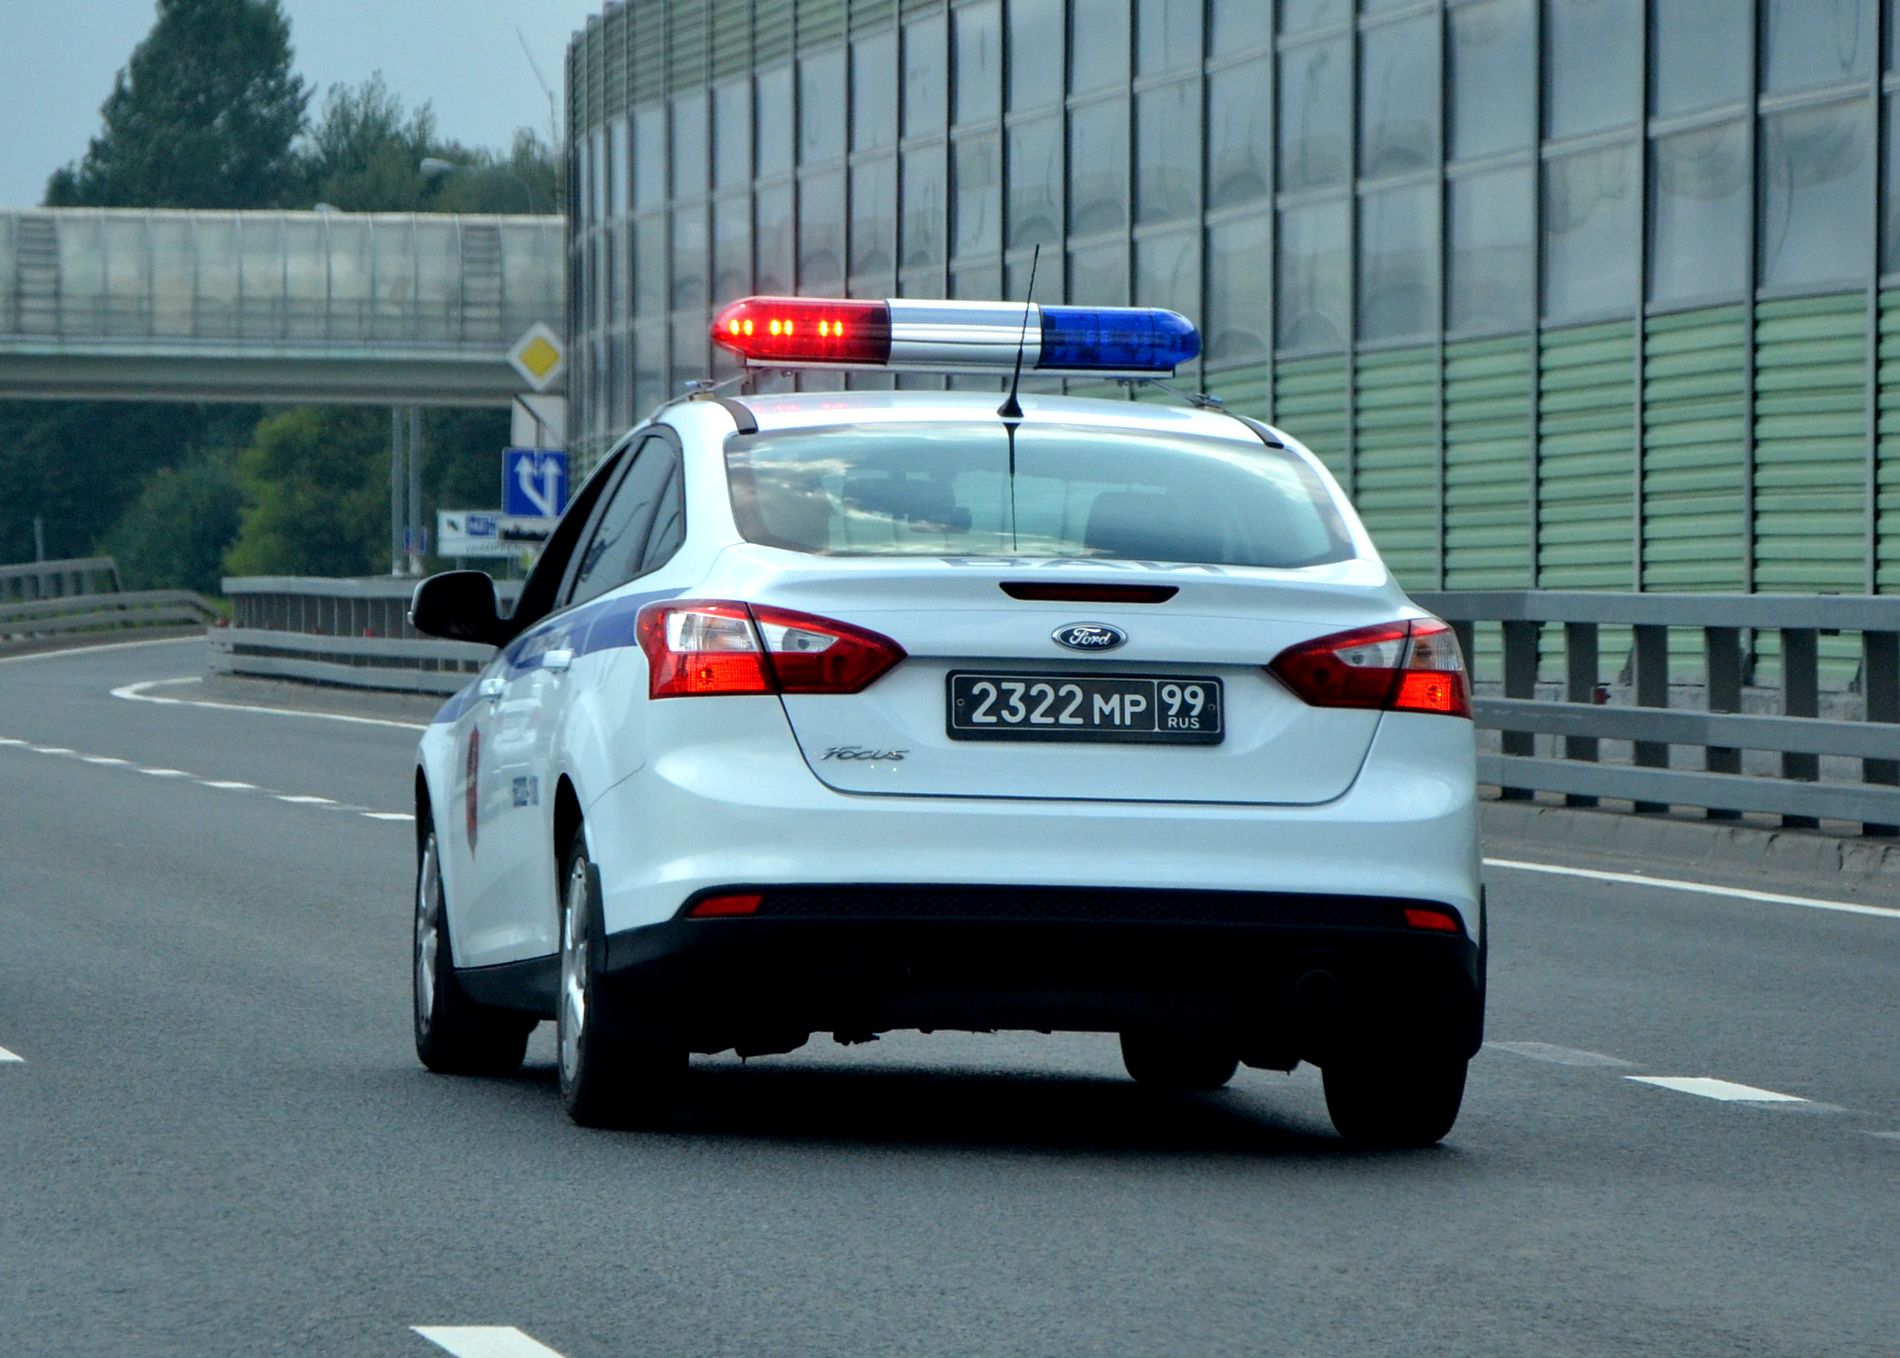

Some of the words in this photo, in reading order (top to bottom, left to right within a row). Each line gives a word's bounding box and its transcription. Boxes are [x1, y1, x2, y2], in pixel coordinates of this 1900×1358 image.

[1068, 627, 1112, 646] Ford
[971, 681, 1085, 726] 2322
[1092, 693, 1148, 726] MP
[1161, 684, 1205, 717] 99
[1167, 717, 1201, 729] RUS
